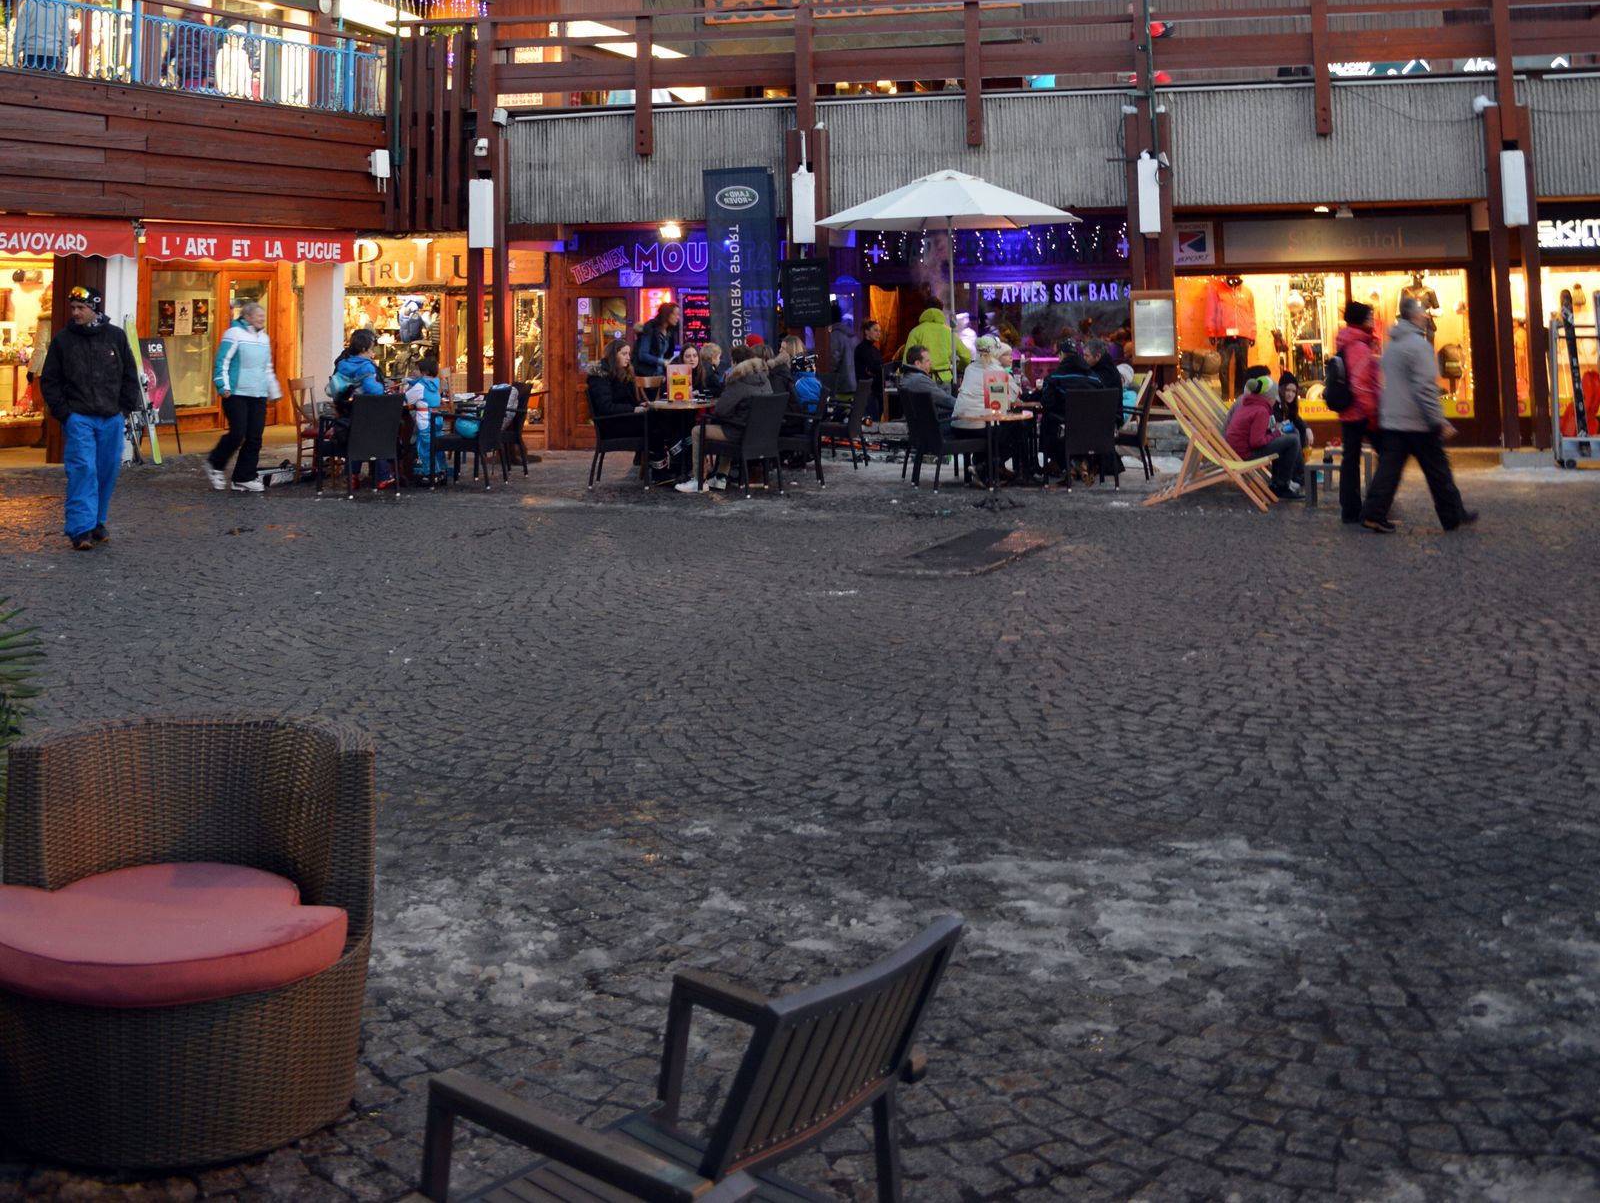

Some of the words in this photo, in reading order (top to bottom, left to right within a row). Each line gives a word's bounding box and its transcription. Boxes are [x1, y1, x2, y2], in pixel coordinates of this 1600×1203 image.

[0, 233, 88, 251] SAVOYARD
[231, 239, 251, 257] ET
[265, 241, 284, 258] LA
[296, 241, 341, 260] FUGUE
[570, 246, 629, 285] TEX-MEX
[1088, 281, 1119, 301] BAR
